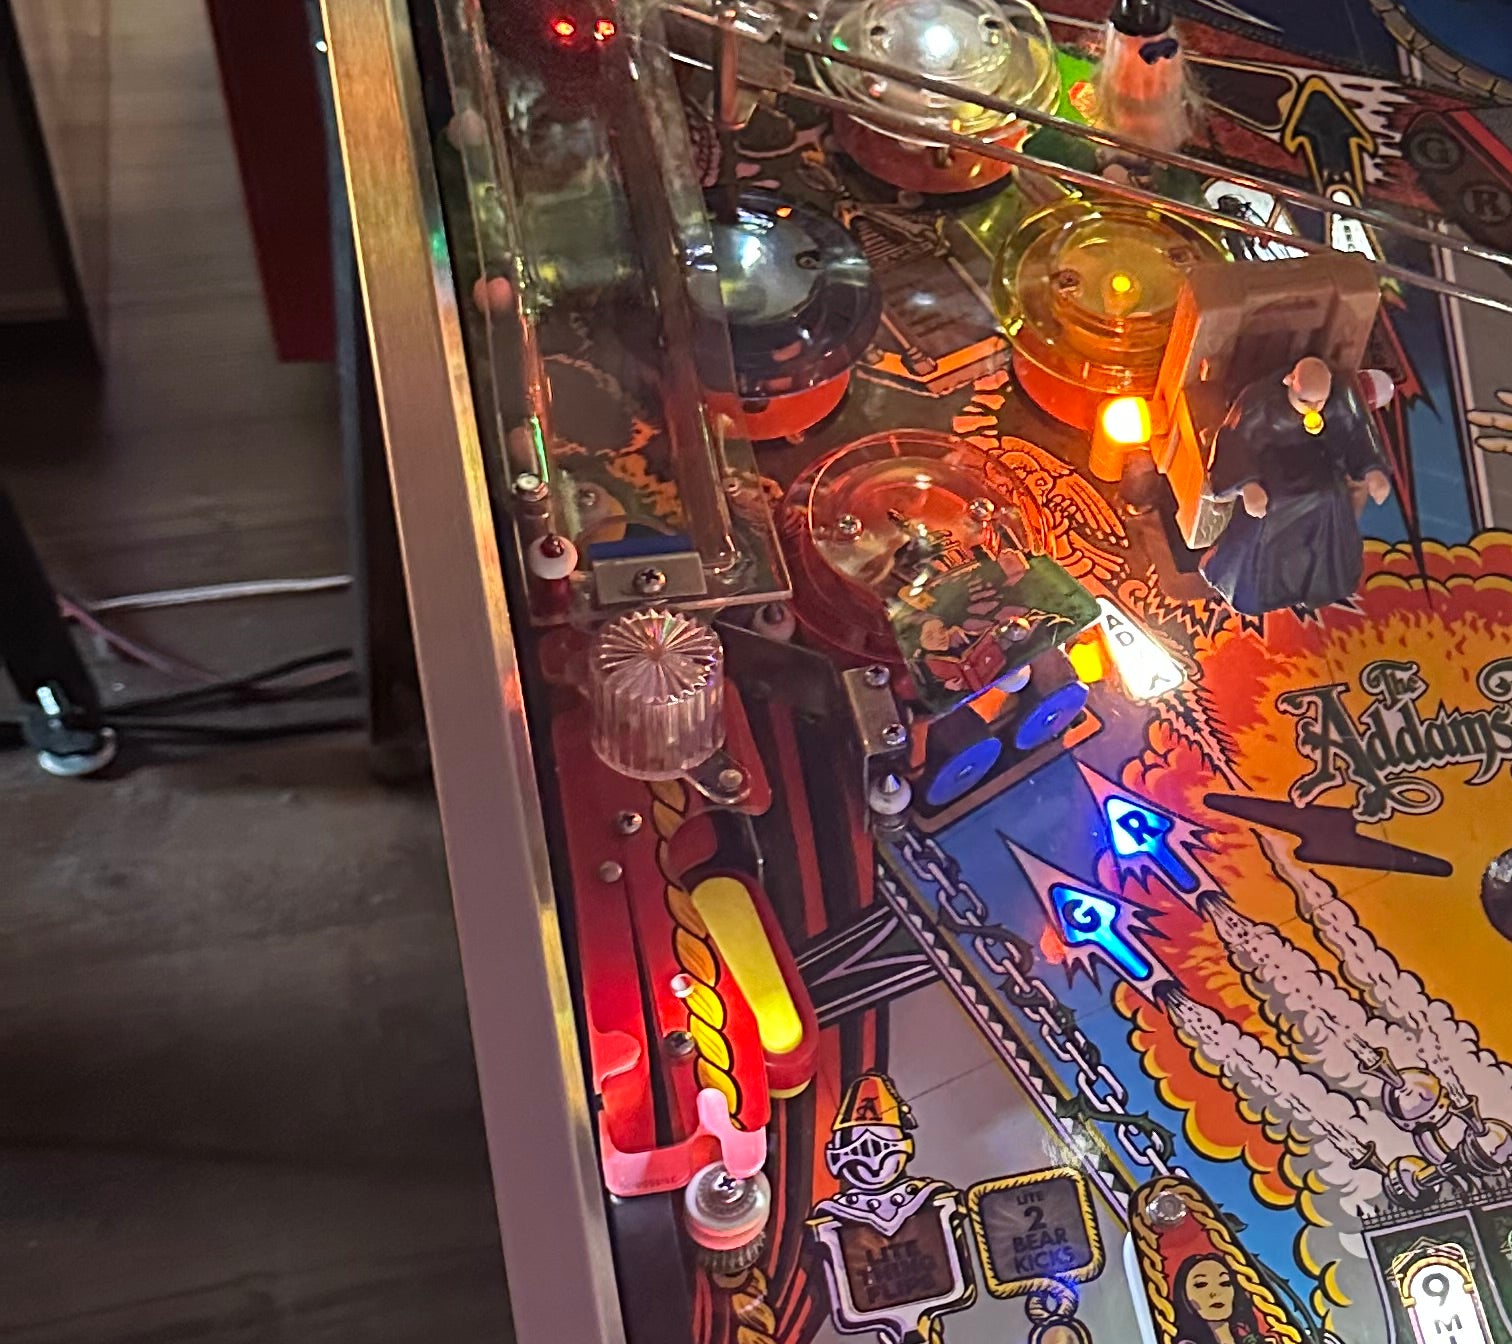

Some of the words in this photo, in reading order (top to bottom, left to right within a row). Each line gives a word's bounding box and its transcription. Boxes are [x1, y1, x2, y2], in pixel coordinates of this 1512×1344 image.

[1361, 661, 1426, 707] The
[1117, 810, 1164, 846] R
[1063, 899, 1101, 933] G
[1015, 1191, 1045, 1206] LITE
[1023, 1207, 1045, 1232] 2
[1012, 1229, 1067, 1254] BEAR
[1013, 1246, 1075, 1274] KICKS
[1422, 1272, 1450, 1307] 9
